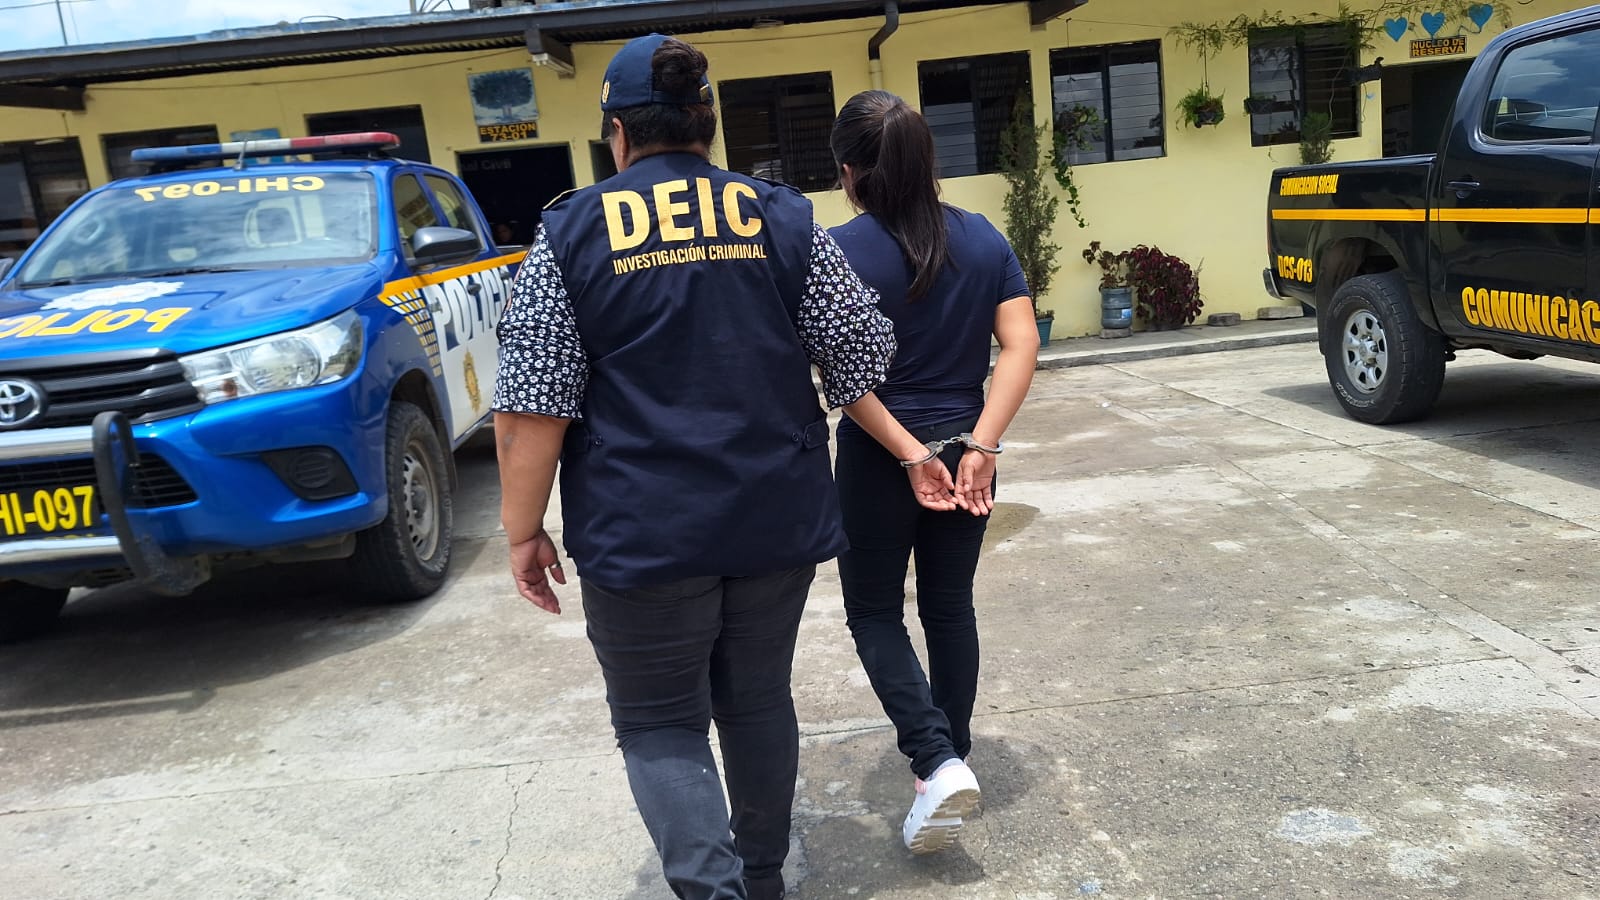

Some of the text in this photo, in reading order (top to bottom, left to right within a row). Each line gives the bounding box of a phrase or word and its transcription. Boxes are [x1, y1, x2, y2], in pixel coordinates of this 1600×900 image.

[1412, 46, 1464, 56] RESERVA
[1452, 37, 1464, 46] DE
[480, 123, 536, 135] ESTACION
[491, 132, 527, 141] 73-01
[601, 177, 762, 251] DEIC
[613, 242, 767, 275] INVESTIGACIÓN CRIMINAL
[1277, 255, 1313, 283] DCS-013
[1461, 286, 1600, 345] COMUNICAC
